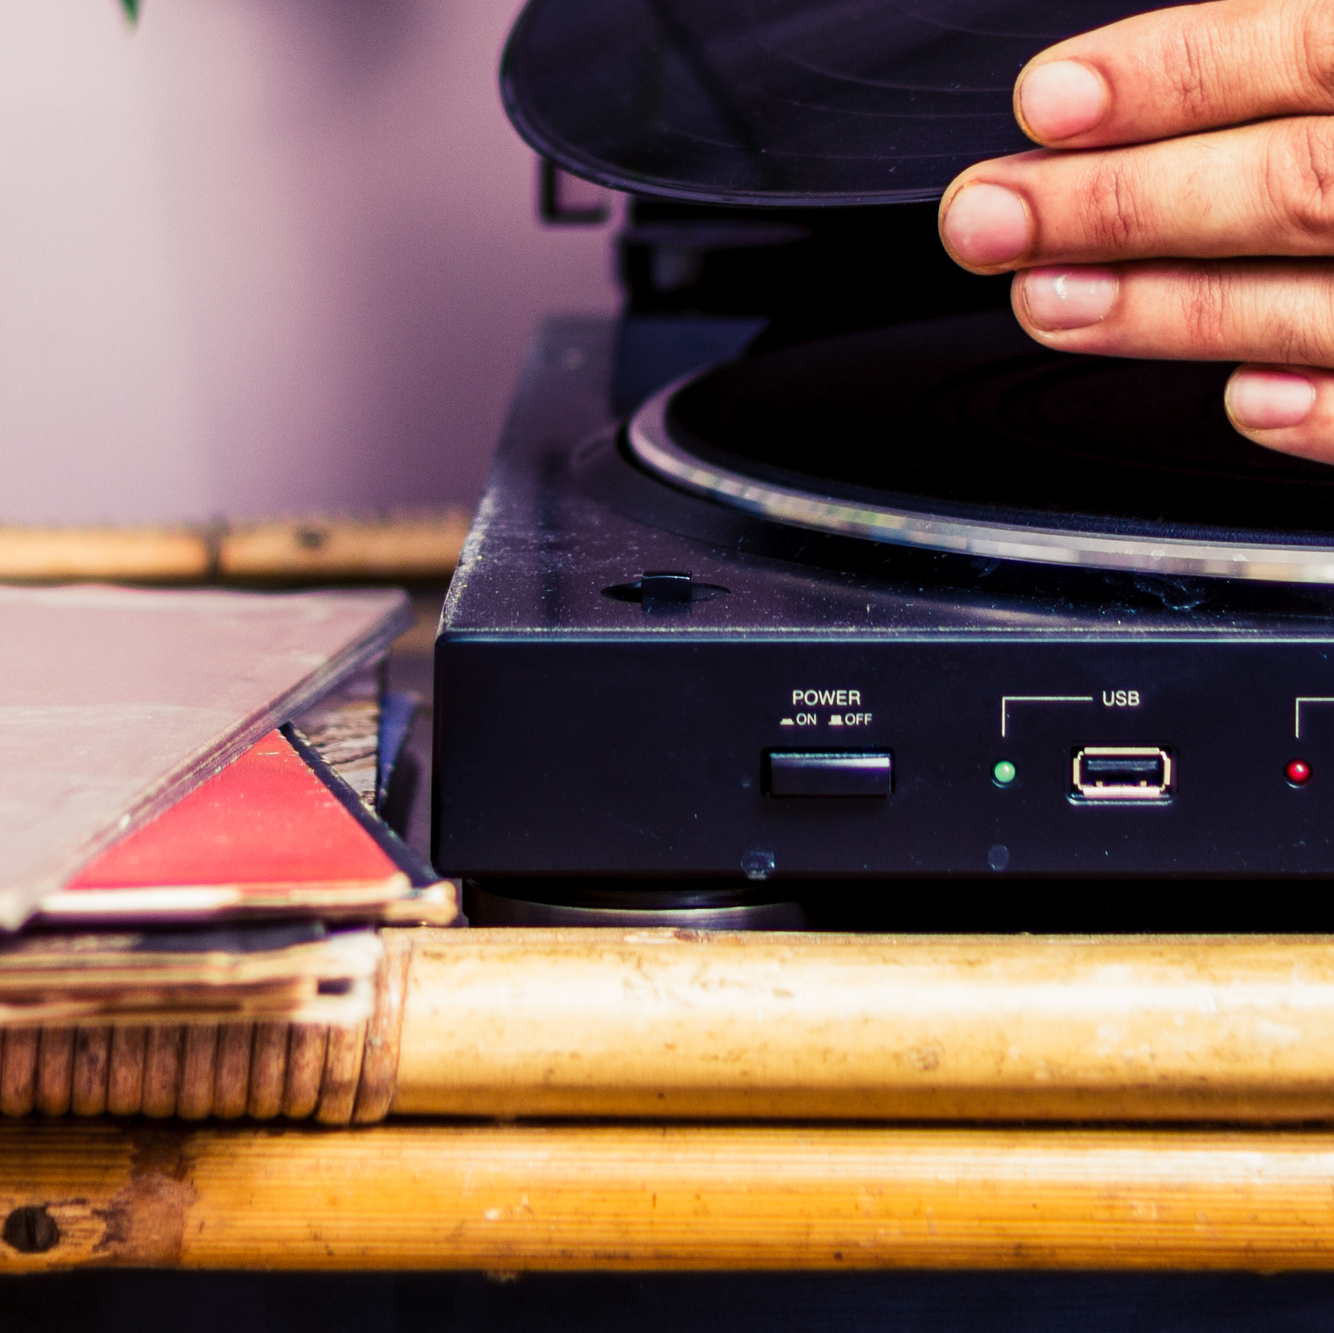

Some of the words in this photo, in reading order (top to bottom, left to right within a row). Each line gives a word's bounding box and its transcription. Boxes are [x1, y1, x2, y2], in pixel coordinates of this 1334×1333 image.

[792, 689, 861, 706] POWER
[1101, 690, 1141, 707] USB
[796, 712, 817, 726] ON
[844, 712, 873, 726] OFF
